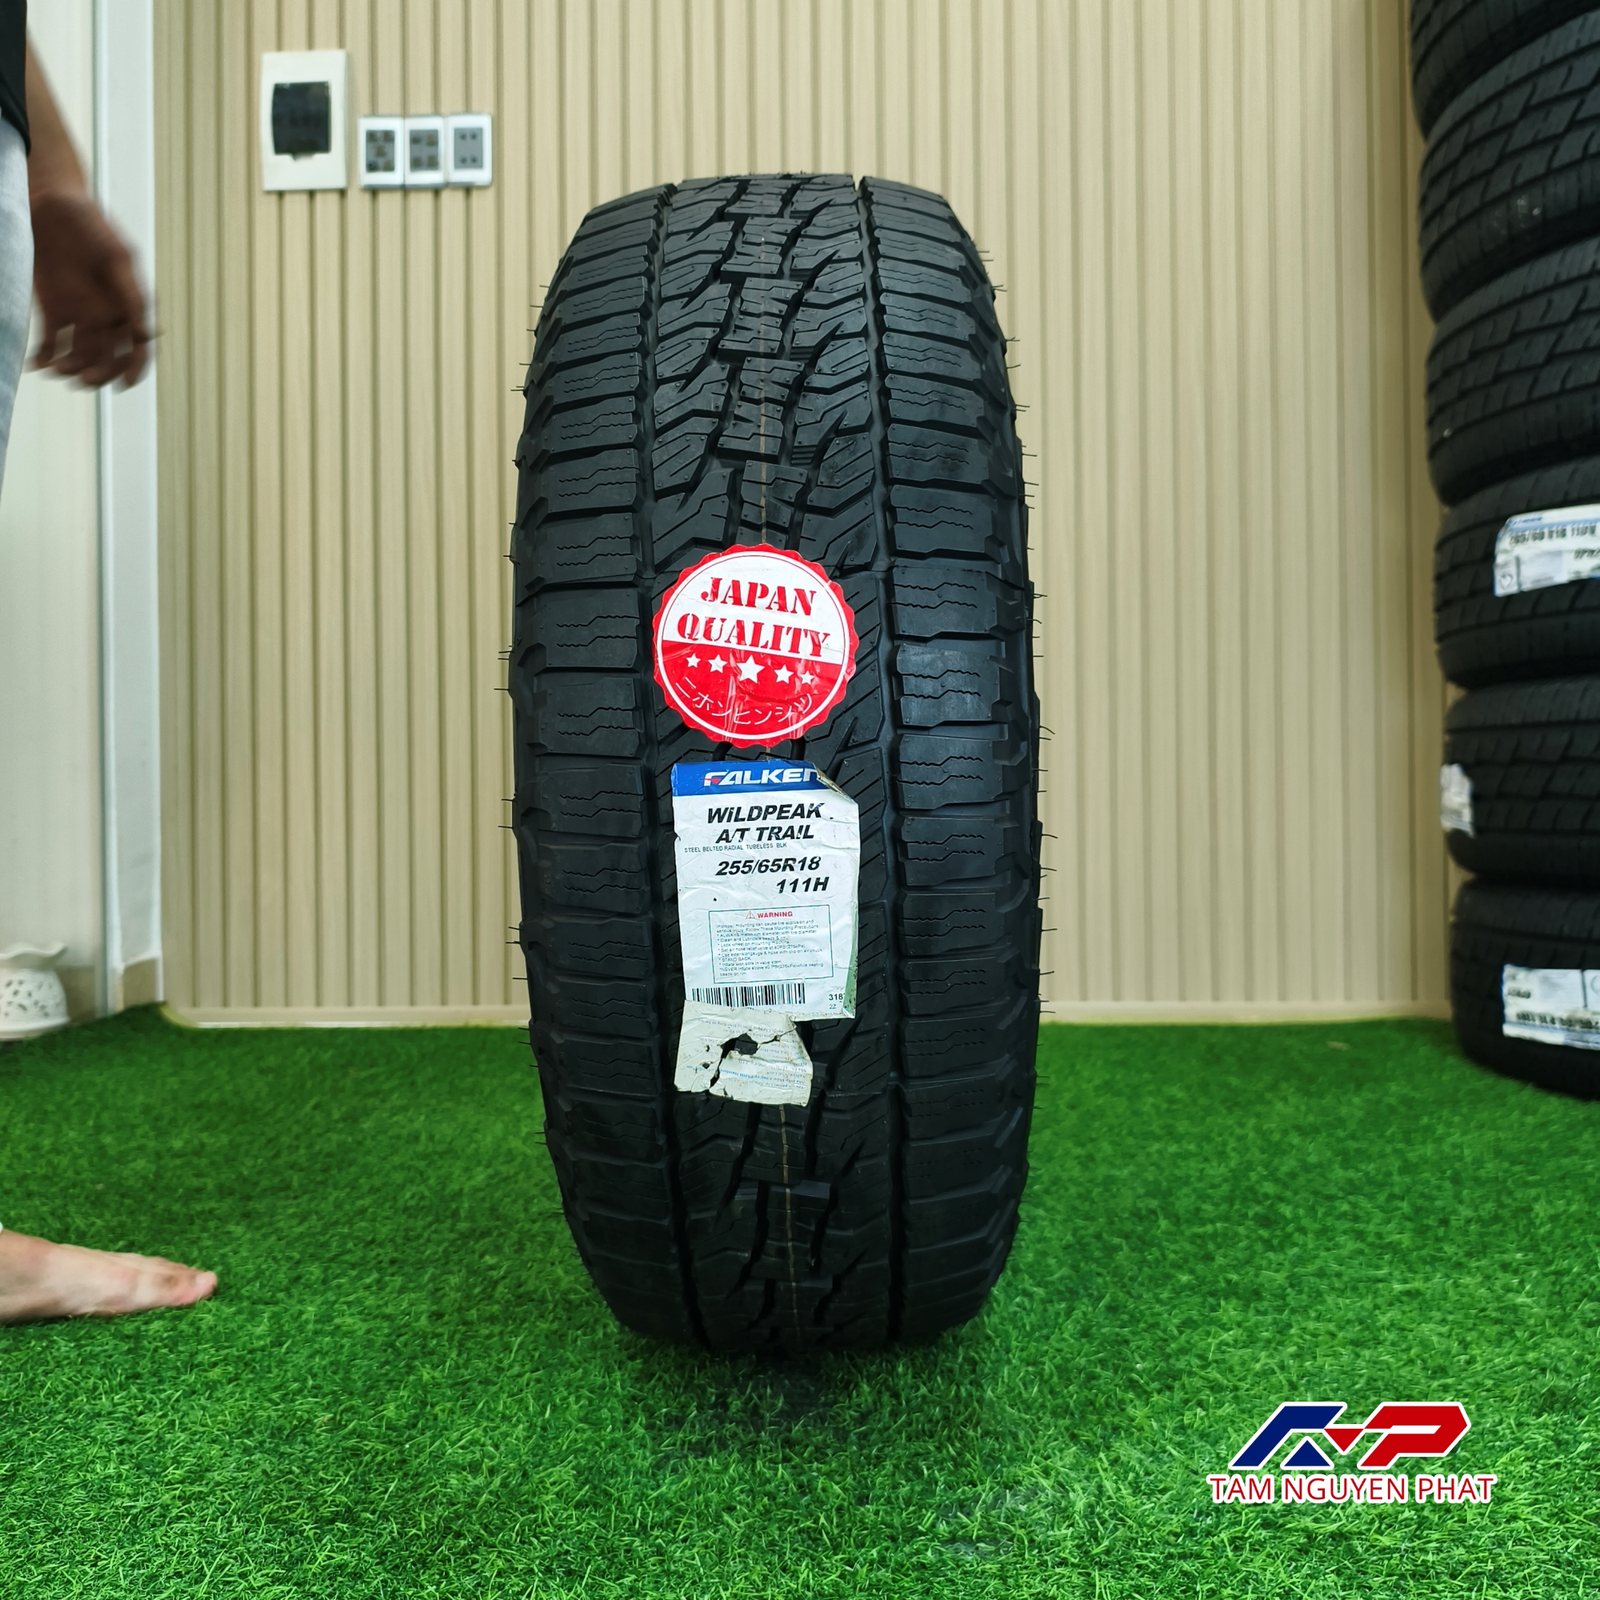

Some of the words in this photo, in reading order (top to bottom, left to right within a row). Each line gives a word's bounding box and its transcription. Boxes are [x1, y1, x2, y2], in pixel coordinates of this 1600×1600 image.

[700, 577, 817, 616] JAPAN
[677, 613, 831, 657] QUALITY
[706, 802, 825, 824] WILDPEAK
[715, 827, 751, 843] A/T
[756, 824, 815, 841] TRAIL
[746, 842, 774, 850] TUBELESS
[715, 856, 822, 876] 255/65R18
[776, 876, 830, 894] 111H
[756, 911, 793, 919] WARNING
[828, 993, 845, 1001] 318
